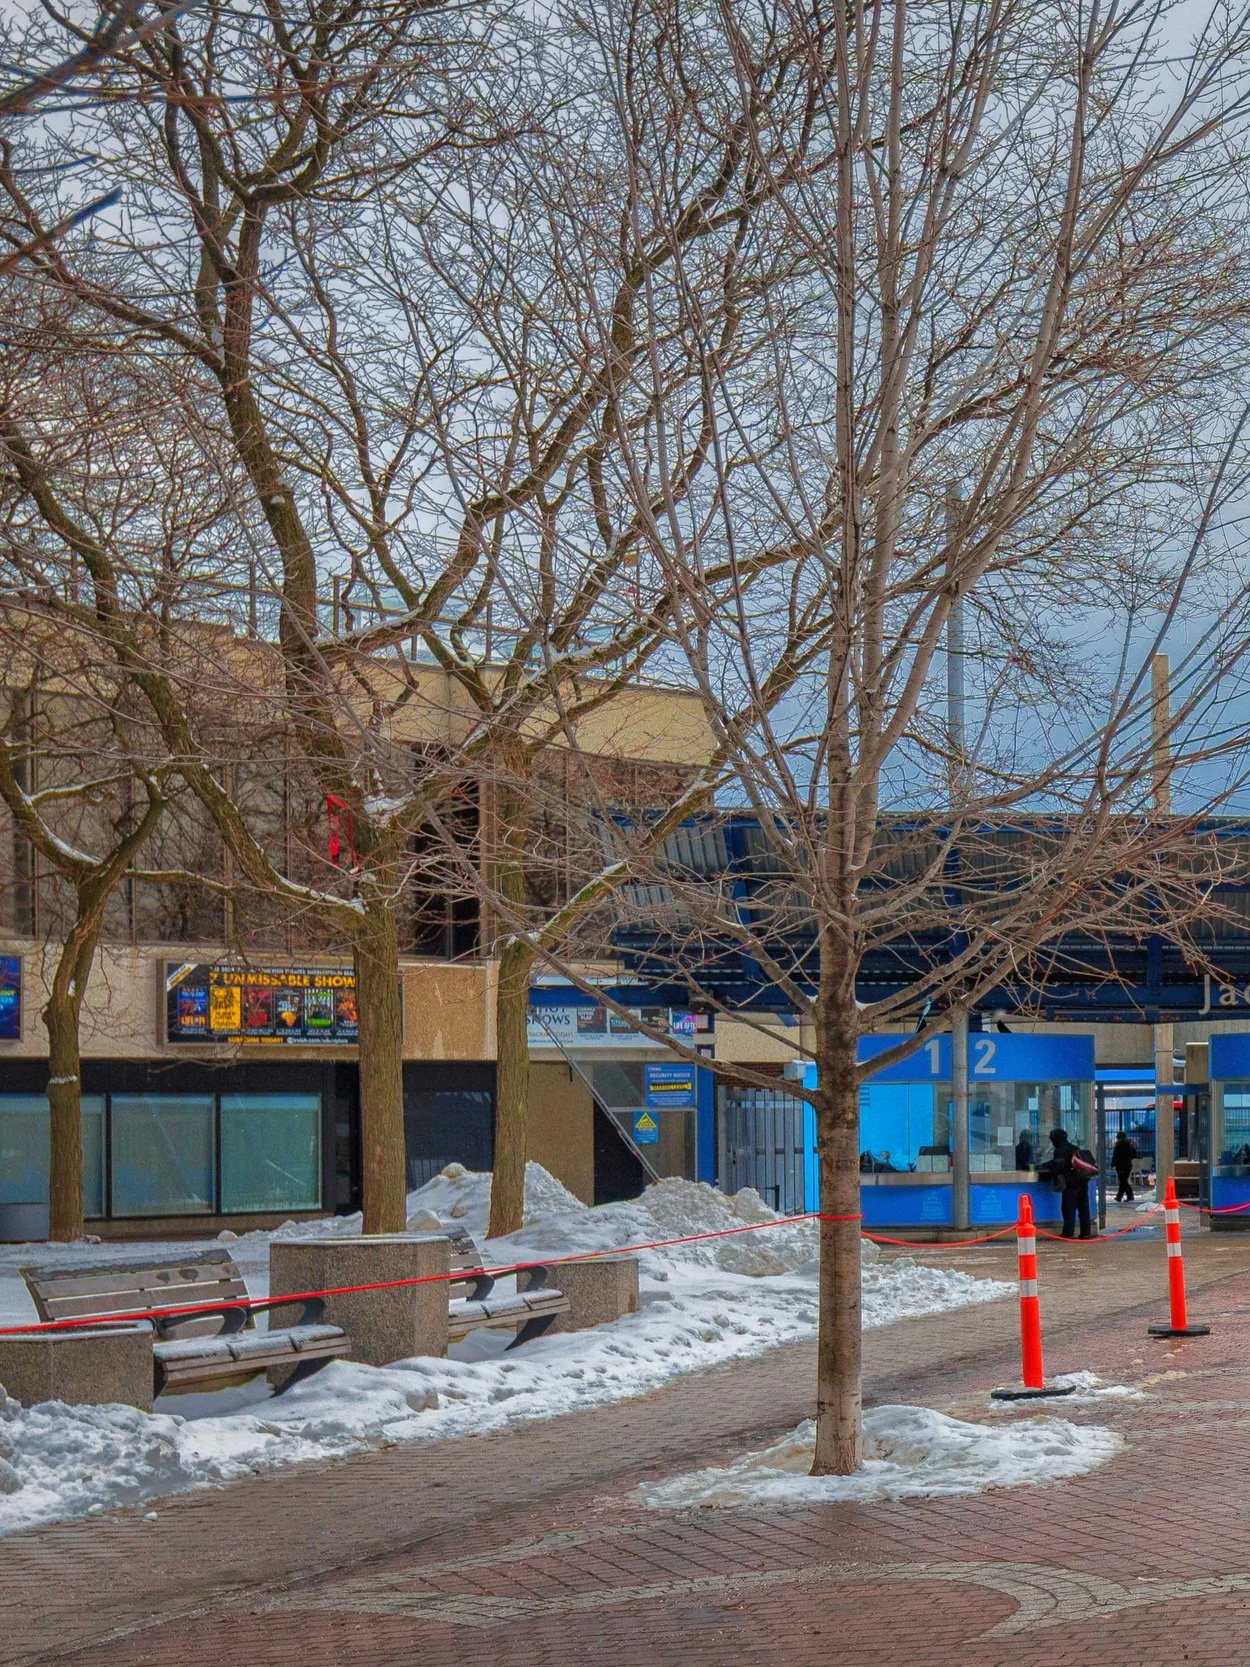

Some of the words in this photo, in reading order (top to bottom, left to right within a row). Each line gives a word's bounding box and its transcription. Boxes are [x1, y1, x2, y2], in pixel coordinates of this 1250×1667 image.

[223, 972, 311, 986] UNMISSABLE
[314, 976, 357, 987] SHOW
[925, 1039, 940, 1074] 1
[974, 1039, 996, 1074] 2
